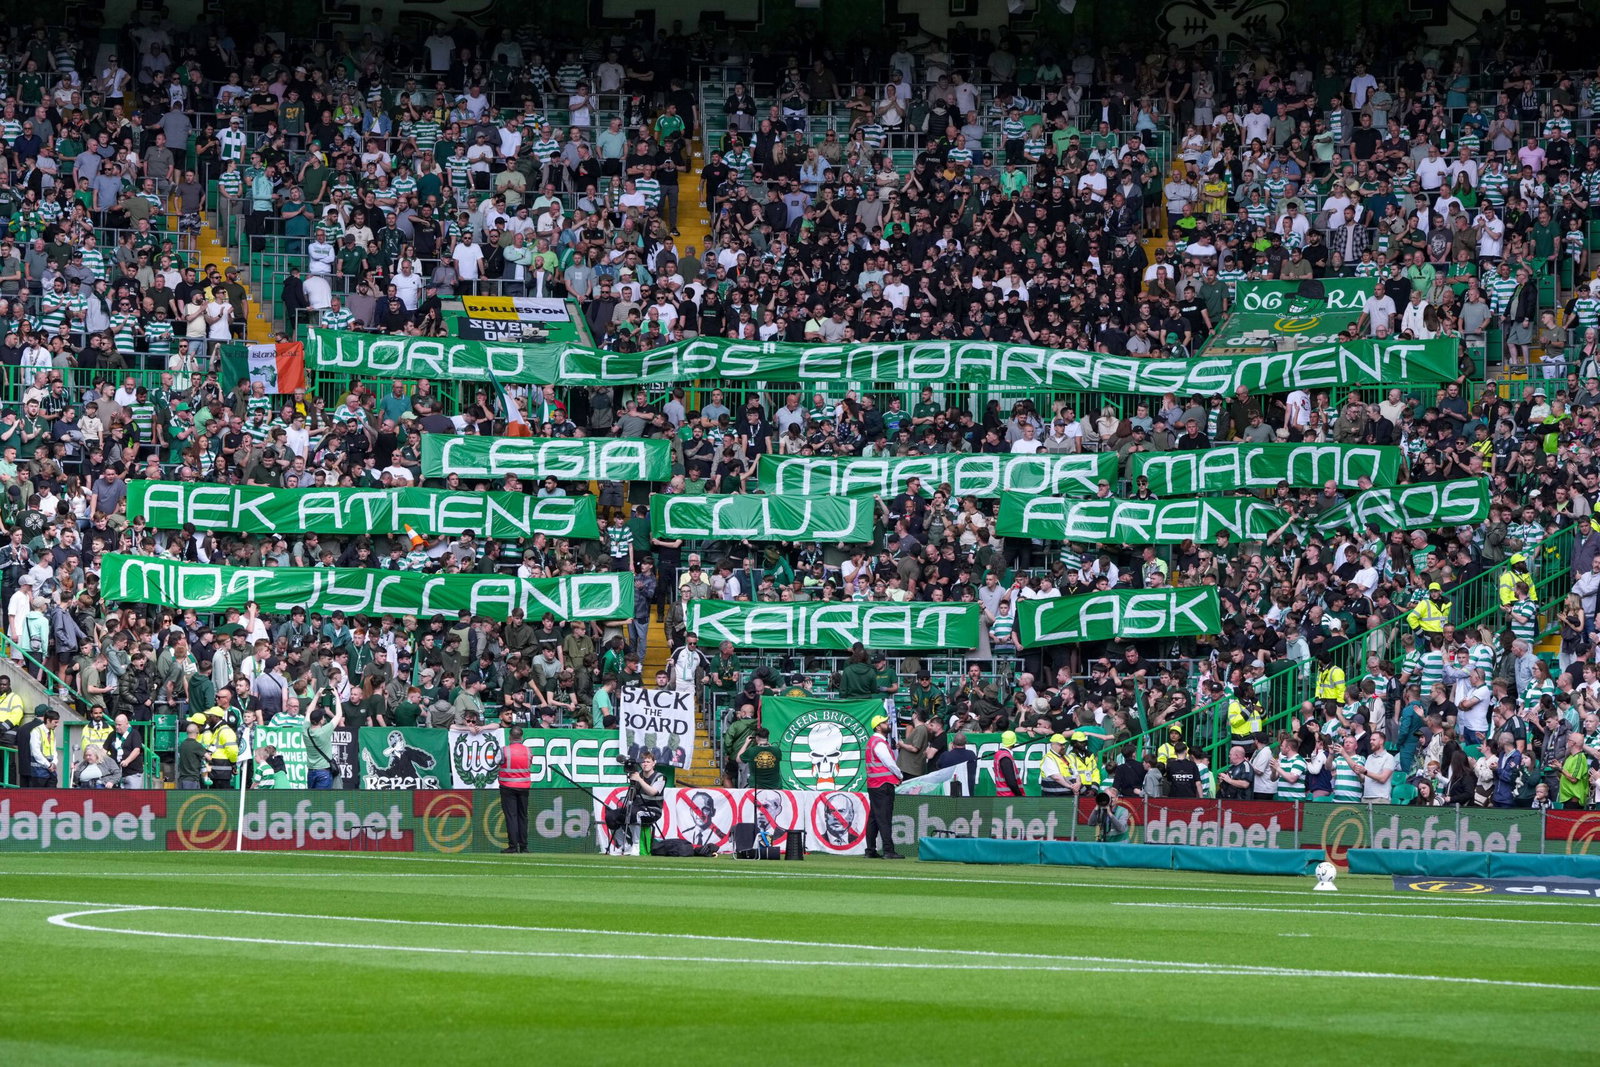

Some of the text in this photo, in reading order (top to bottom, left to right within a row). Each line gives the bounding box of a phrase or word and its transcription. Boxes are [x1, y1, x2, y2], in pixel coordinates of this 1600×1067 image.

[468, 305, 564, 315] BAILLIESTON
[469, 319, 532, 332] SEVEN
[1226, 333, 1339, 347] dafbet
[798, 343, 1425, 394] EMBARRASSMENT
[442, 437, 646, 479] LEGIA
[776, 454, 1098, 497] MARIBOR
[1142, 446, 1381, 494] MALMO
[143, 484, 576, 536] AEK ATHENS
[664, 496, 857, 538] CLUJ
[692, 603, 967, 647] KAIRAT
[1034, 591, 1209, 641] LASK
[622, 686, 690, 711] SACK
[643, 707, 662, 717] THE
[784, 712, 818, 743] GREEN
[823, 711, 869, 743] BRIGADE
[522, 738, 631, 784] GREE
[241, 799, 403, 848] dafabet
[1147, 807, 1281, 849] dafabet
[1374, 815, 1521, 853] dafabet
